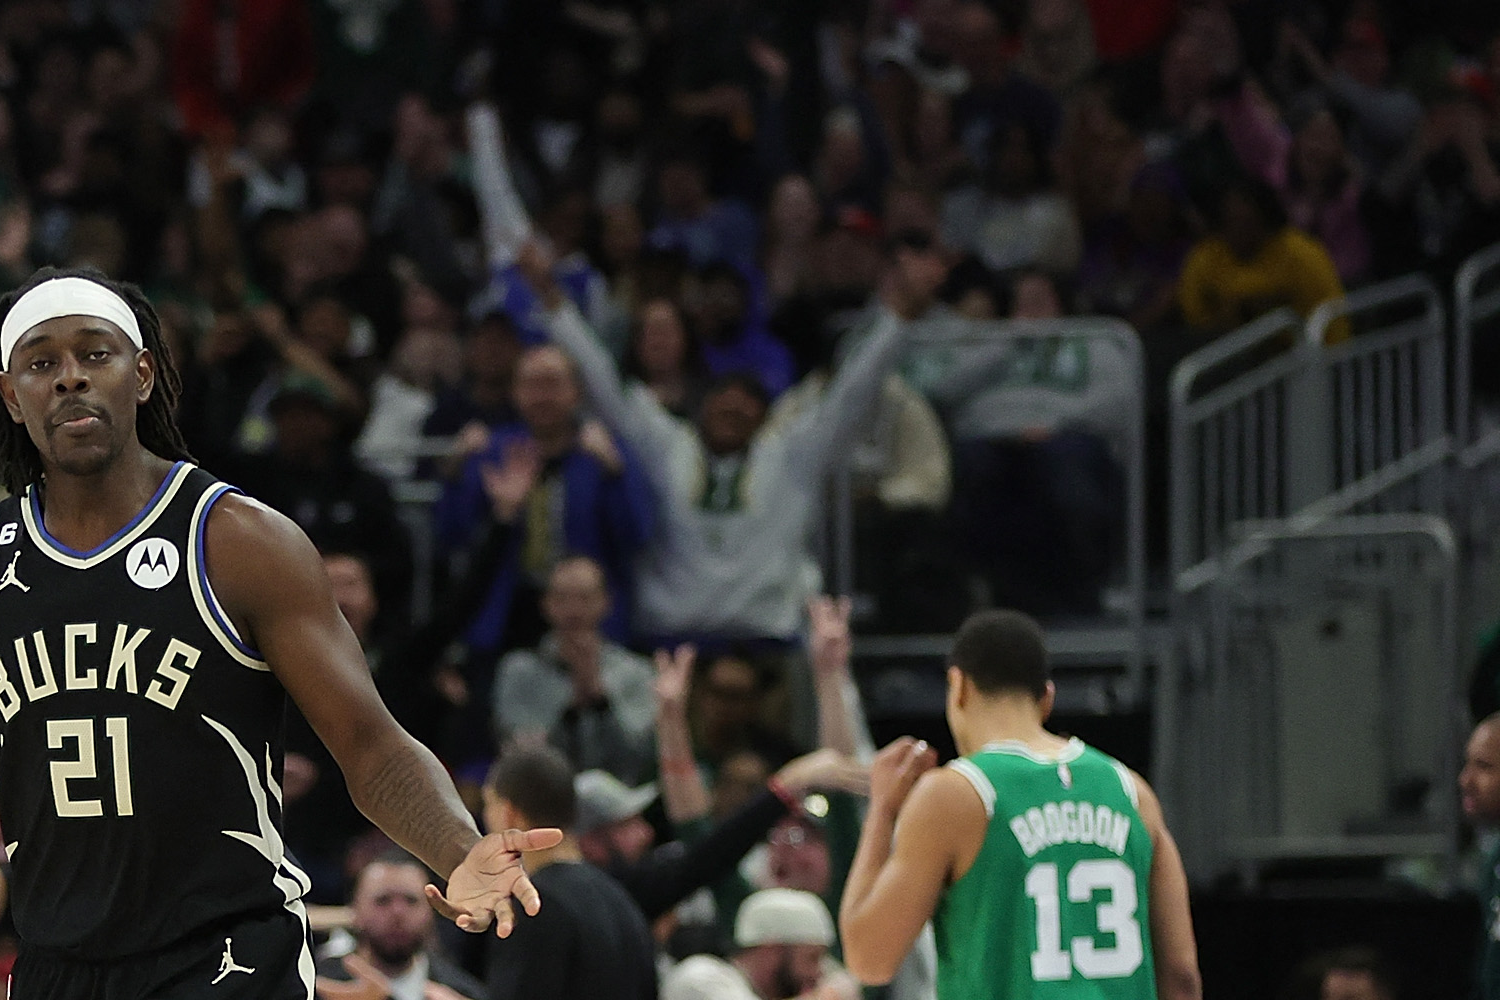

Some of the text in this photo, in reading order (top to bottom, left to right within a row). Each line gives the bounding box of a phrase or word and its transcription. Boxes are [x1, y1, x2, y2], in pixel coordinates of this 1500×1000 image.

[46, 716, 134, 818] 21
[1009, 801, 1131, 858] BROGDON
[1024, 859, 1144, 981] 13
